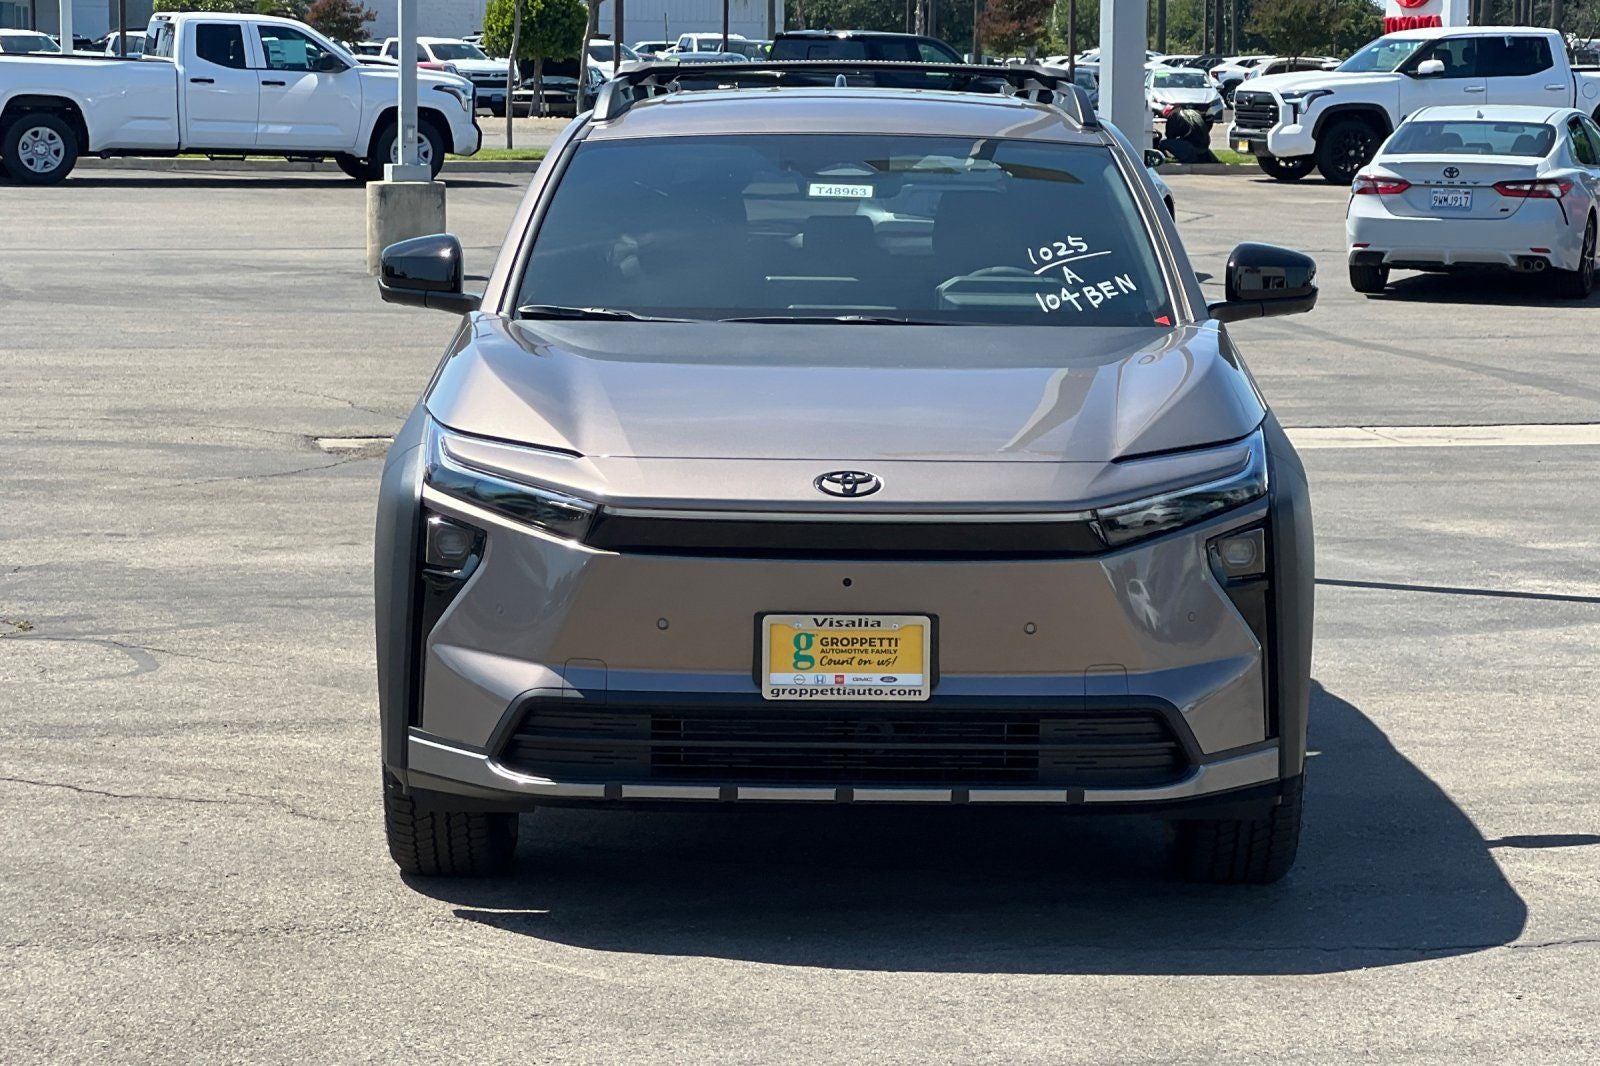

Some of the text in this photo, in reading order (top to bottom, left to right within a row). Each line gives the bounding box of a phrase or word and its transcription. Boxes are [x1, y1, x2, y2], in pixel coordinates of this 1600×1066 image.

[815, 186, 867, 196] T48963
[1027, 235, 1089, 265] 1025
[1062, 265, 1084, 284] A
[813, 617, 882, 628] Visalia
[820, 637, 899, 648] GROPPETTI
[820, 655, 855, 667] Count
[876, 655, 898, 667] us!
[770, 687, 922, 698] groppettiauto.com
